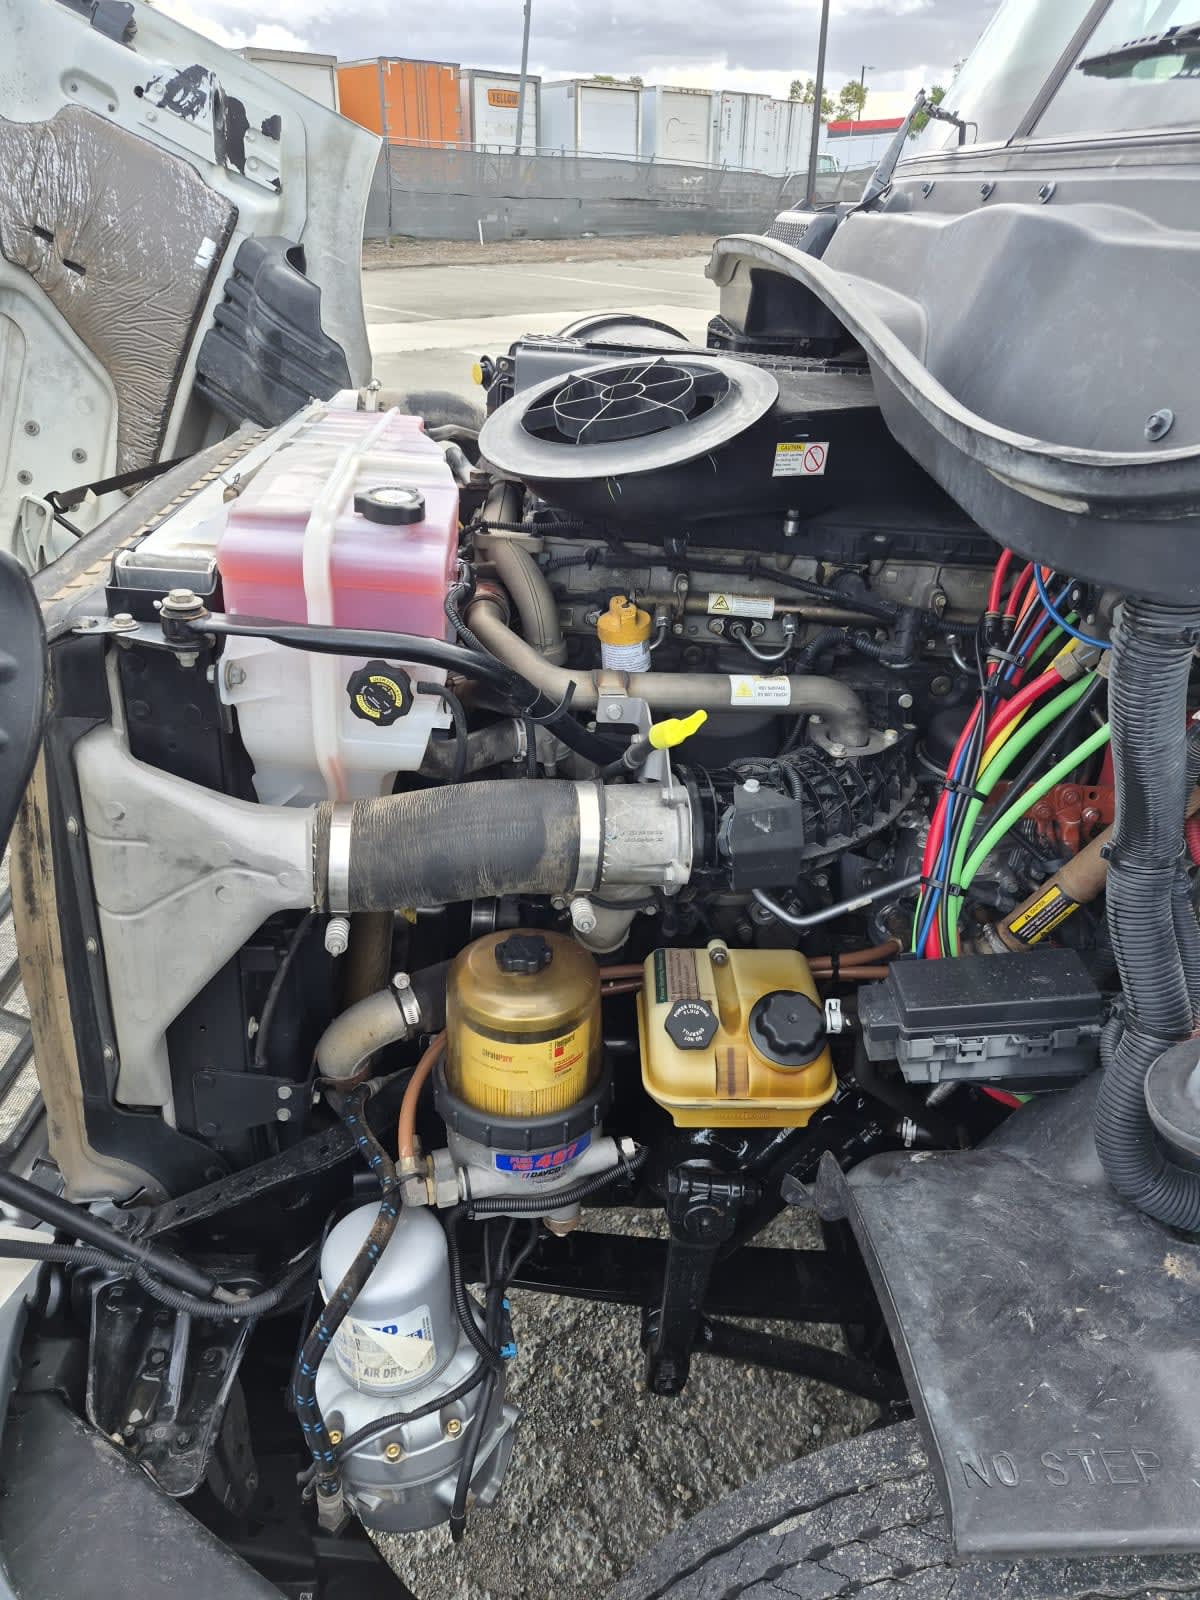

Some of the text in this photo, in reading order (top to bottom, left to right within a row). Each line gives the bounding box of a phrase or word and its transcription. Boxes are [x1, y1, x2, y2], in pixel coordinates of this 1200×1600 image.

[491, 92, 519, 105] YELLOW
[673, 1003, 710, 1018] POWER STEERING
[530, 1166, 562, 1178] DAVCO
[363, 1367, 380, 1379] AIR
[956, 1447, 1161, 1489] NO STEP
